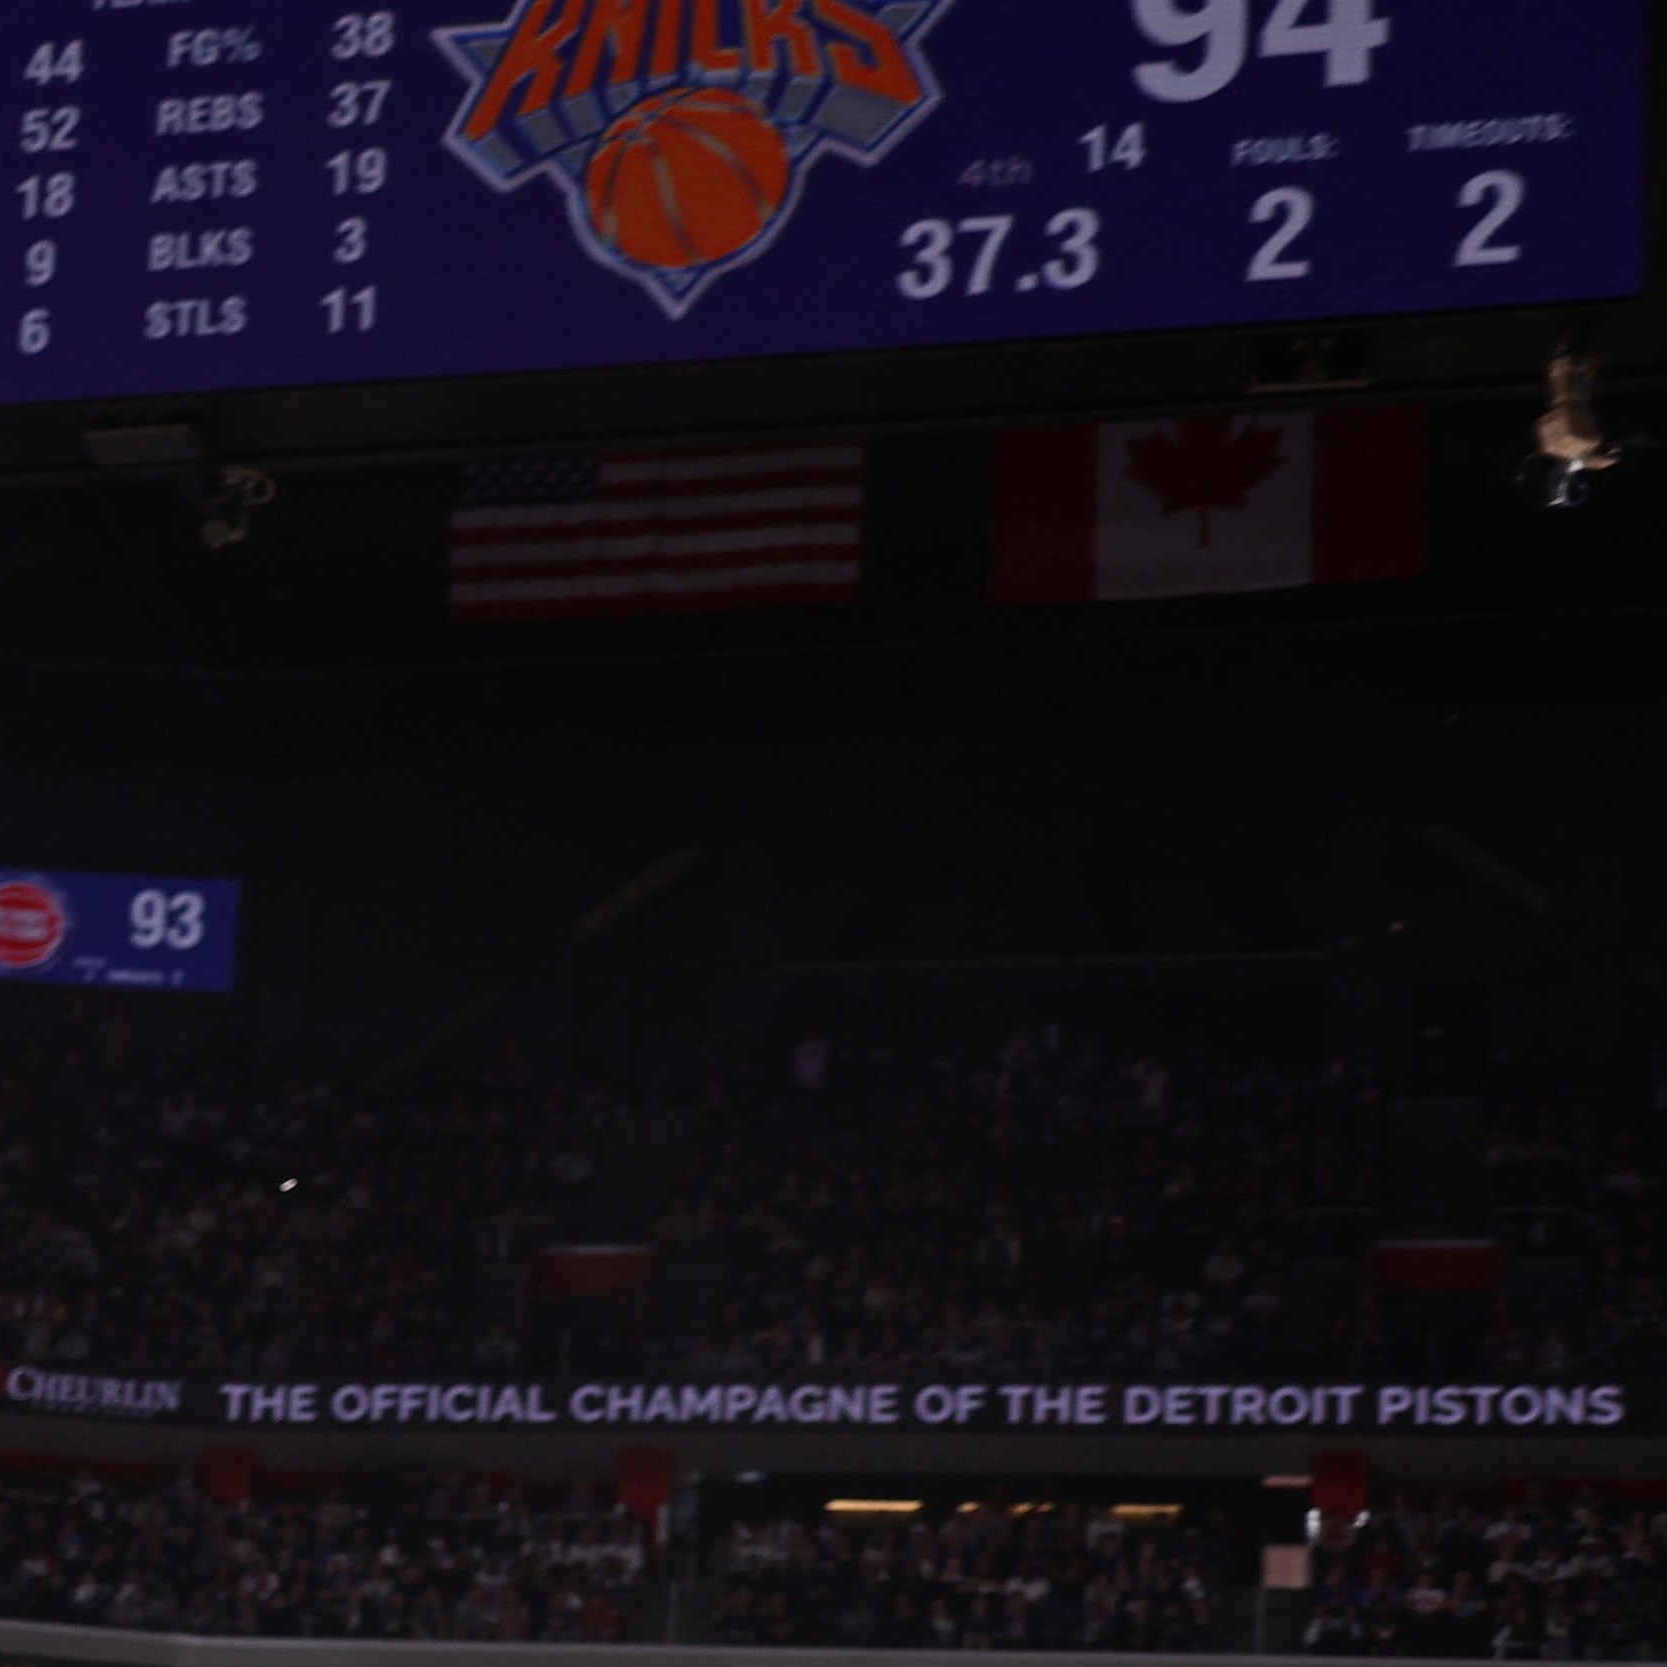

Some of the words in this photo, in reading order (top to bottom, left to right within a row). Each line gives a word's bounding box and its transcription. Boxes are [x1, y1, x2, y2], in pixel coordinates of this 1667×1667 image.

[24, 40, 84, 84] 44
[167, 25, 262, 69] FG%
[331, 12, 394, 60] 38
[462, 0, 920, 139] KNICKS
[1133, 0, 1389, 101] 94
[20, 107, 80, 153] 52
[155, 93, 263, 137] REBS
[329, 79, 391, 128] 37
[1079, 122, 1148, 172] 14
[17, 173, 75, 219] 18
[152, 160, 259, 204] ASTS
[326, 148, 387, 195] 19
[1453, 170, 1524, 268] 2
[25, 242, 57, 287] 9
[147, 229, 253, 272] BLKS
[335, 218, 367, 262] 3
[897, 207, 1101, 300] 37.3
[1245, 186, 1315, 283] 2
[19, 308, 51, 353] 6
[144, 297, 248, 340] STLS
[319, 285, 377, 332] 11
[129, 889, 205, 950] 93
[219, 1383, 319, 1424] THE
[330, 1384, 554, 1425] OFFICIAL
[570, 1384, 901, 1426] CHAMPAGNE
[914, 1384, 982, 1426] OF
[999, 1384, 1107, 1426] THE
[1122, 1385, 1354, 1427] DETROIT
[1377, 1385, 1625, 1427] PISTONS
